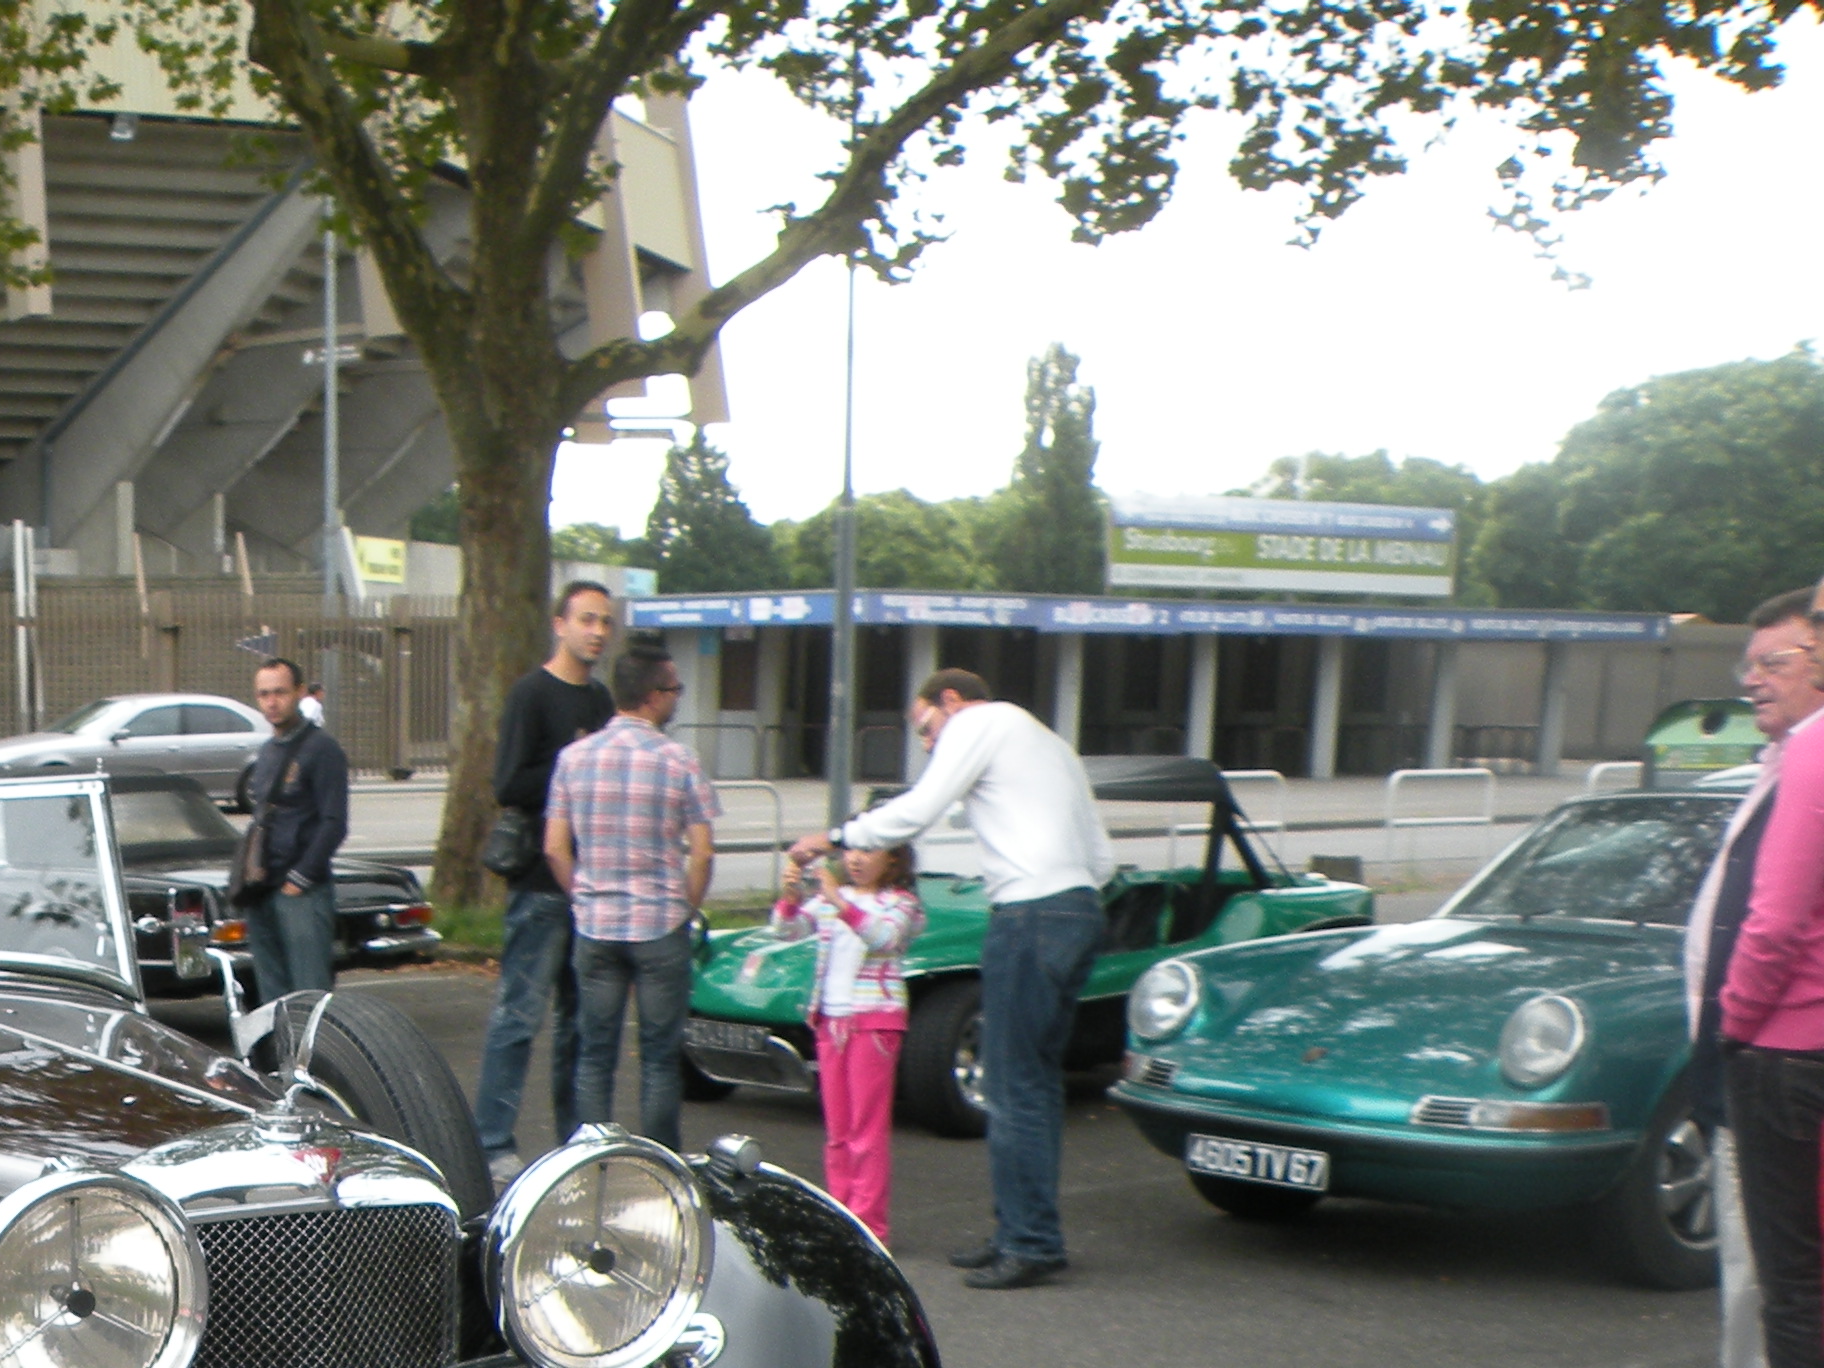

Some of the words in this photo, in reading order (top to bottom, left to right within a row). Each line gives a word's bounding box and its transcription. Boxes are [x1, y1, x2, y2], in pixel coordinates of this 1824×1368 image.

[1256, 534, 1315, 561] STADE
[1318, 537, 1344, 562] DE
[1347, 538, 1371, 564] LA
